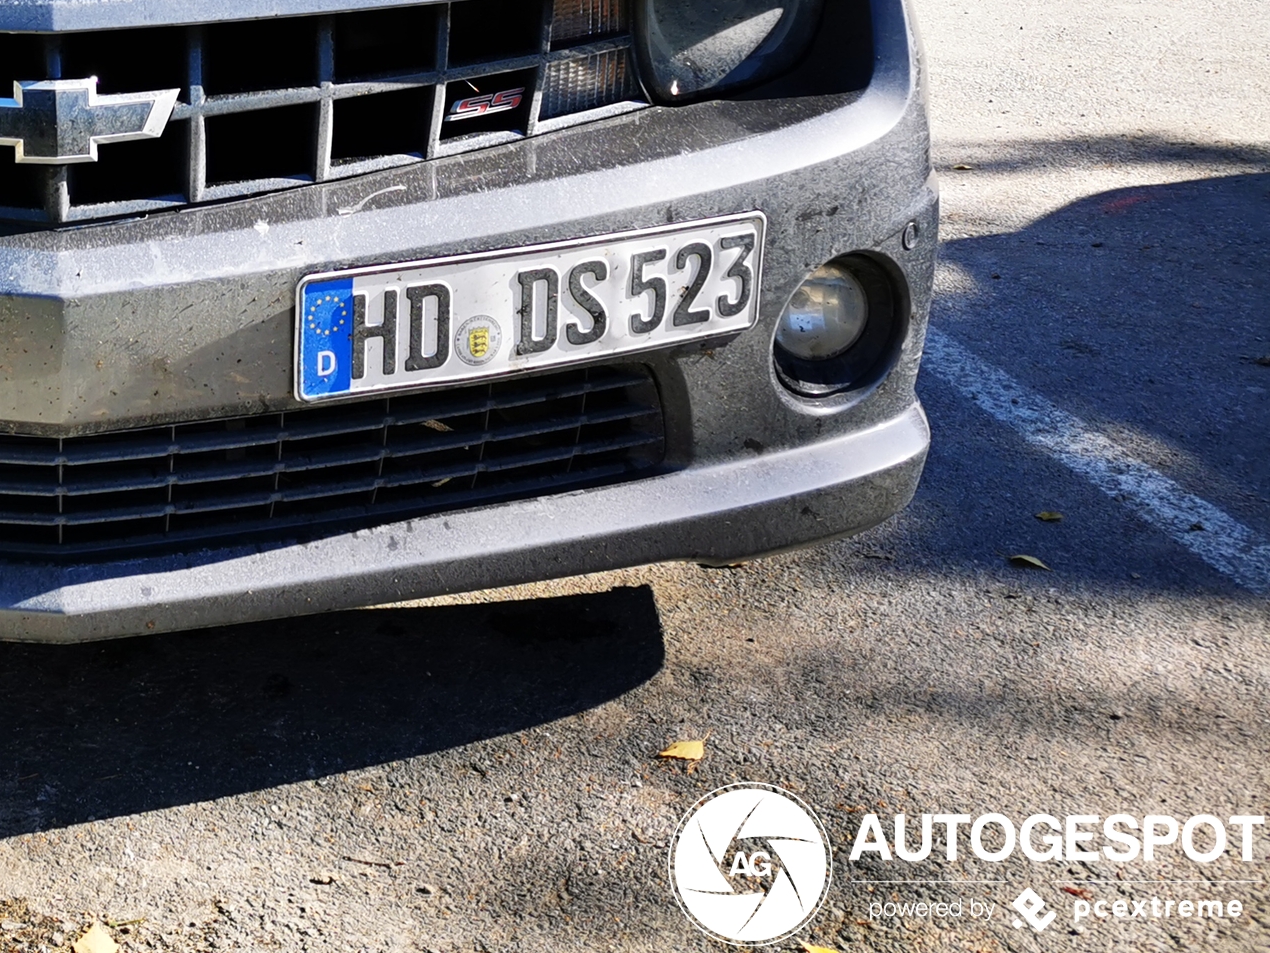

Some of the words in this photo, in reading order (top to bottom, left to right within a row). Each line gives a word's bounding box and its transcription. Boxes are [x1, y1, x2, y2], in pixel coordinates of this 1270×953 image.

[445, 87, 525, 121] SS
[351, 283, 451, 380] HD
[515, 259, 610, 357] DS
[629, 232, 755, 334] 523
[317, 350, 336, 376] D
